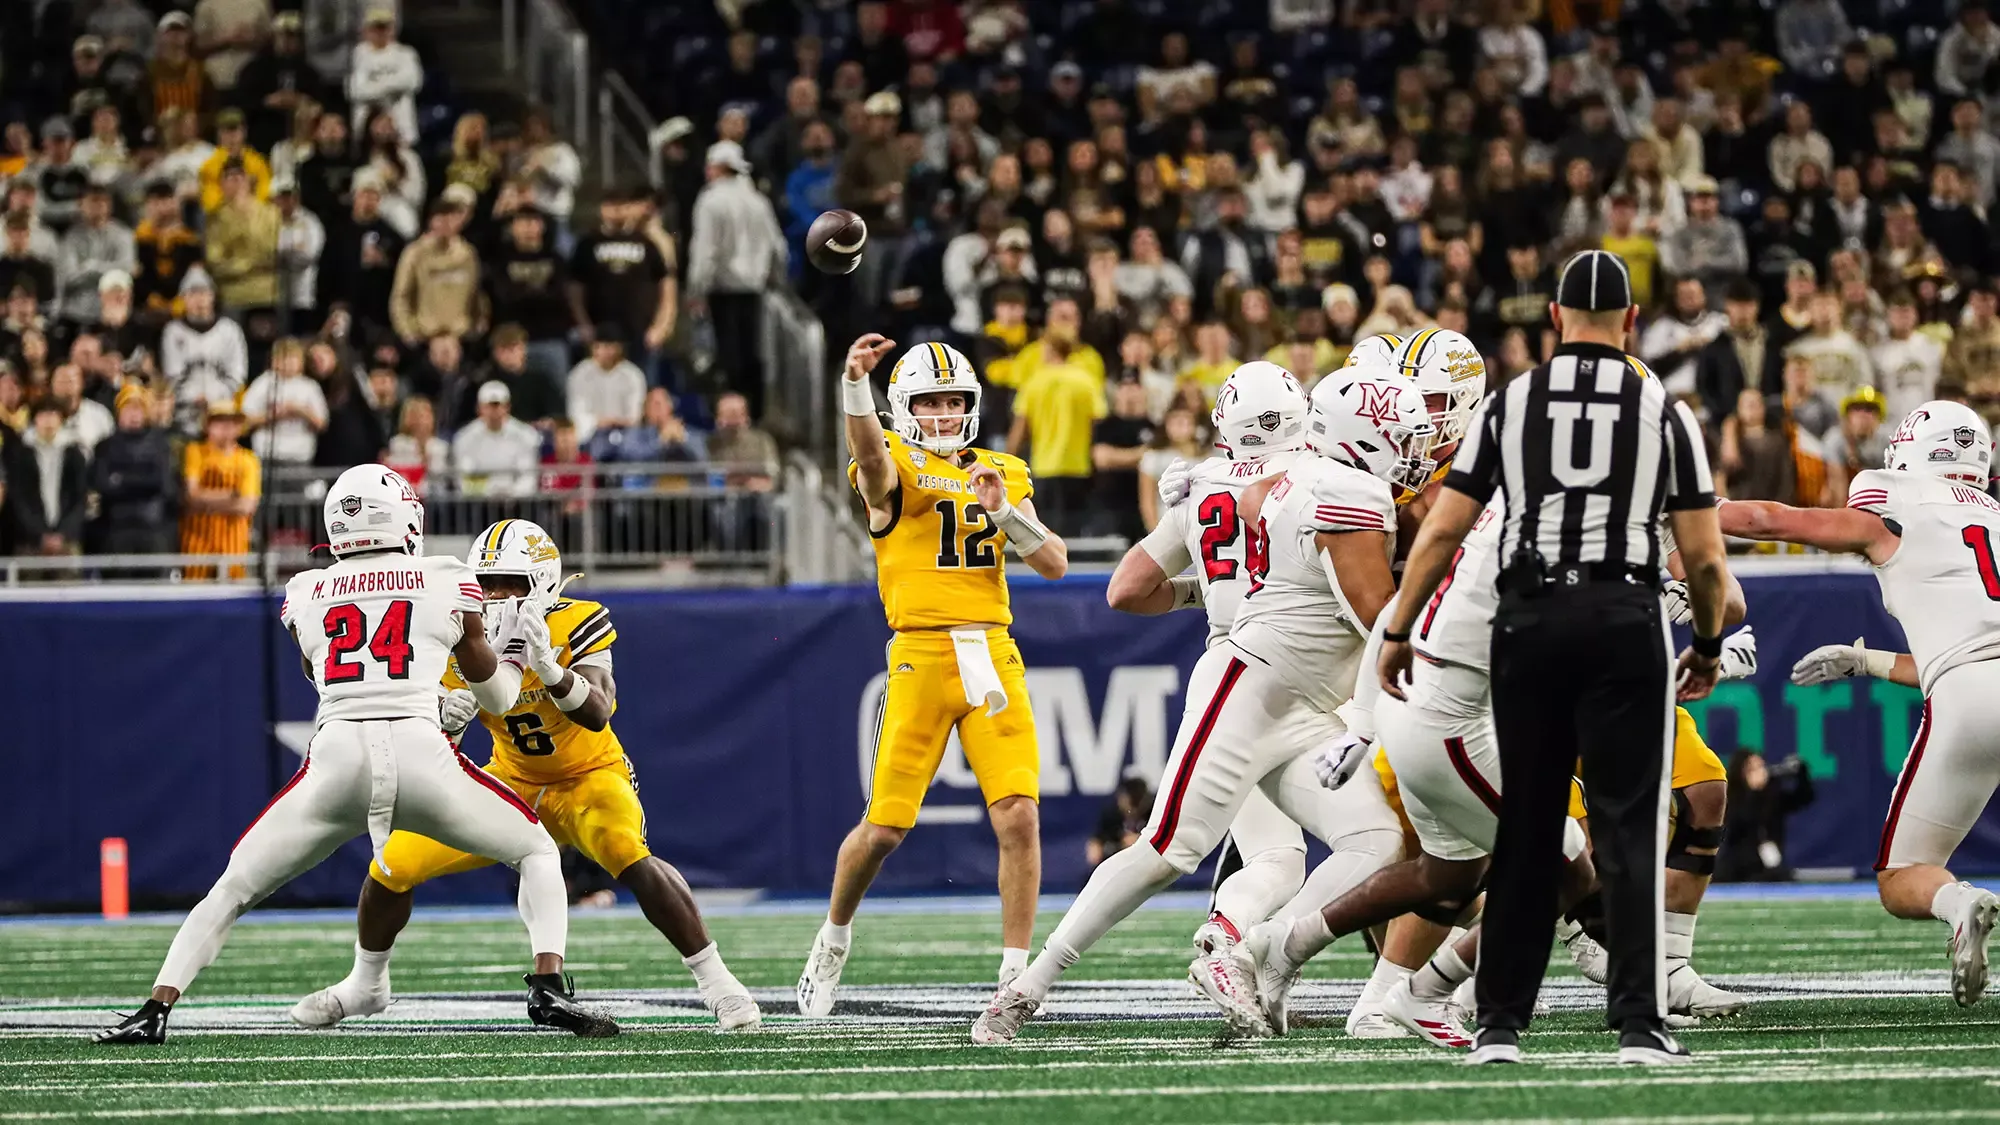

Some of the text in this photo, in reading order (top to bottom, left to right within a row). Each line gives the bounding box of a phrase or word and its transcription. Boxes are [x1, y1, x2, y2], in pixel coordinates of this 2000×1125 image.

[936, 378, 956, 386] GRIT
[1355, 382, 1402, 422] M
[1547, 401, 1621, 487] U
[917, 474, 962, 492] WESTERN
[1229, 460, 1269, 479] TRICK
[934, 499, 996, 569] 12
[311, 571, 425, 600] M. YHARBROUGH
[1566, 569, 1579, 585] S
[323, 600, 414, 686] 24
[503, 711, 556, 757] 6
